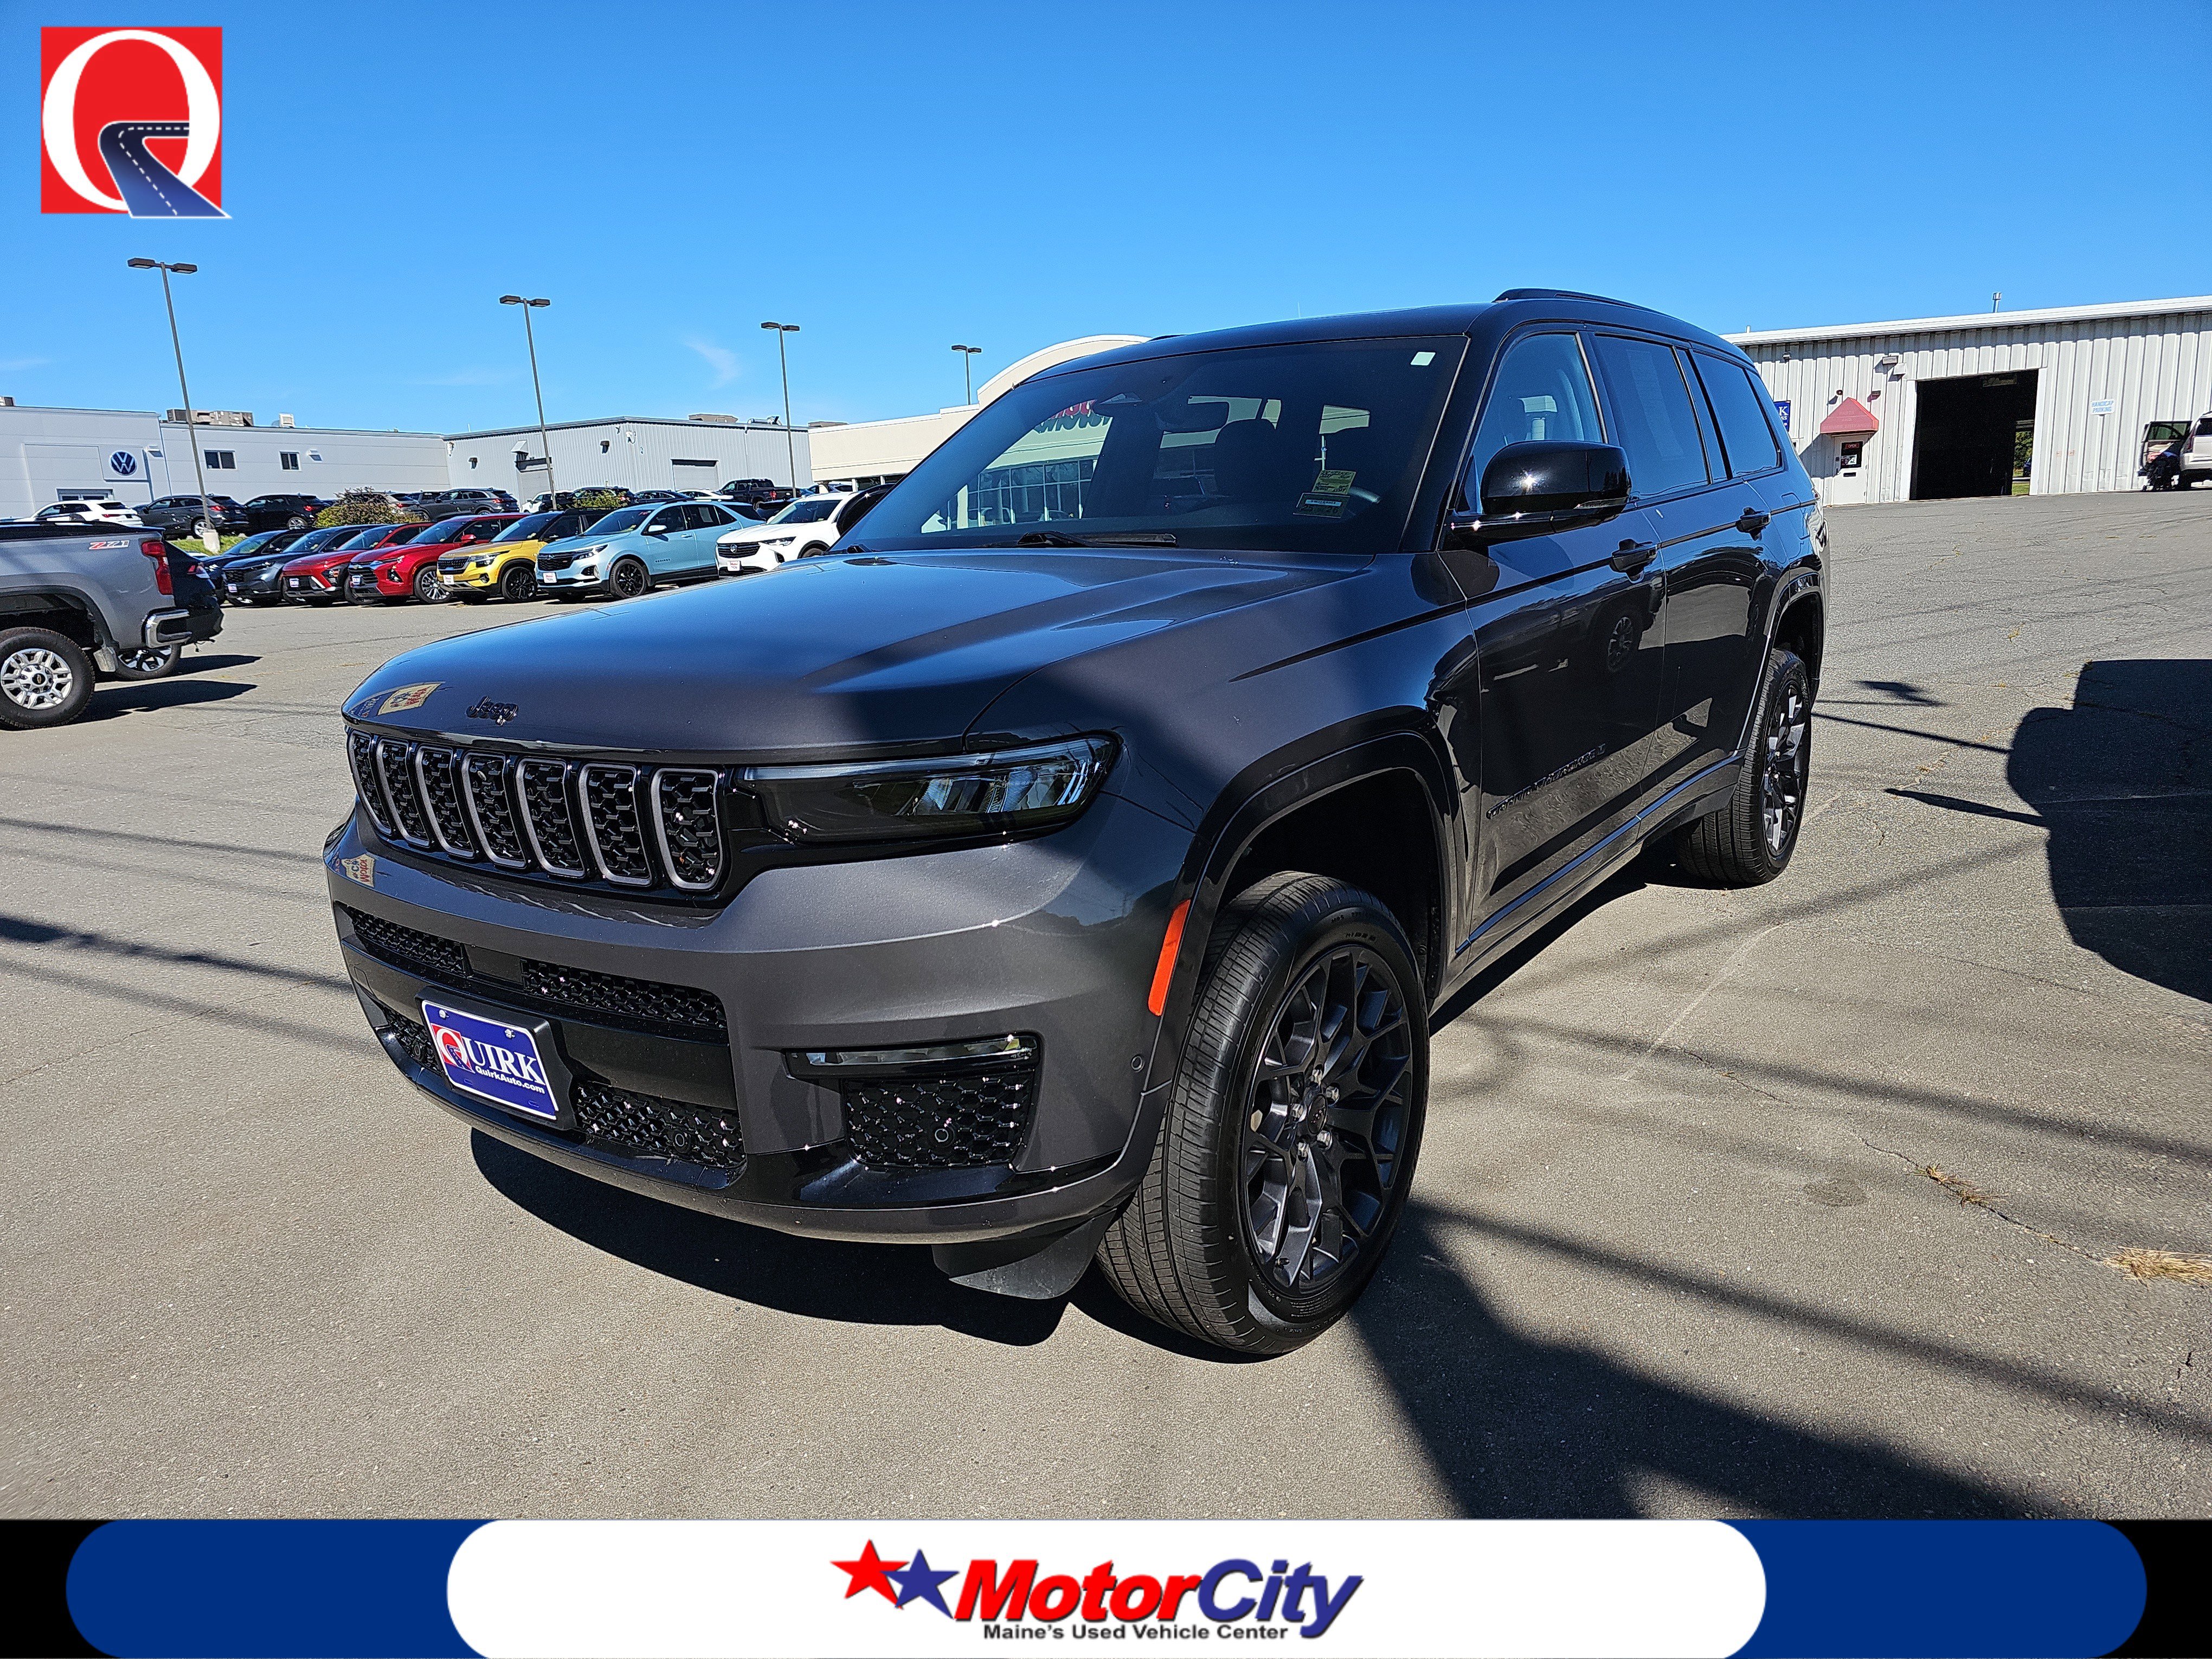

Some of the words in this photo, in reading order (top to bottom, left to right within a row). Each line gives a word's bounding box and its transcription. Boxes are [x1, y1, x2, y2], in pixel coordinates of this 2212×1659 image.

[466, 695, 519, 726] Jeep
[436, 1028, 546, 1086] QUIRK
[475, 1065, 545, 1094] QuirkAuto.com
